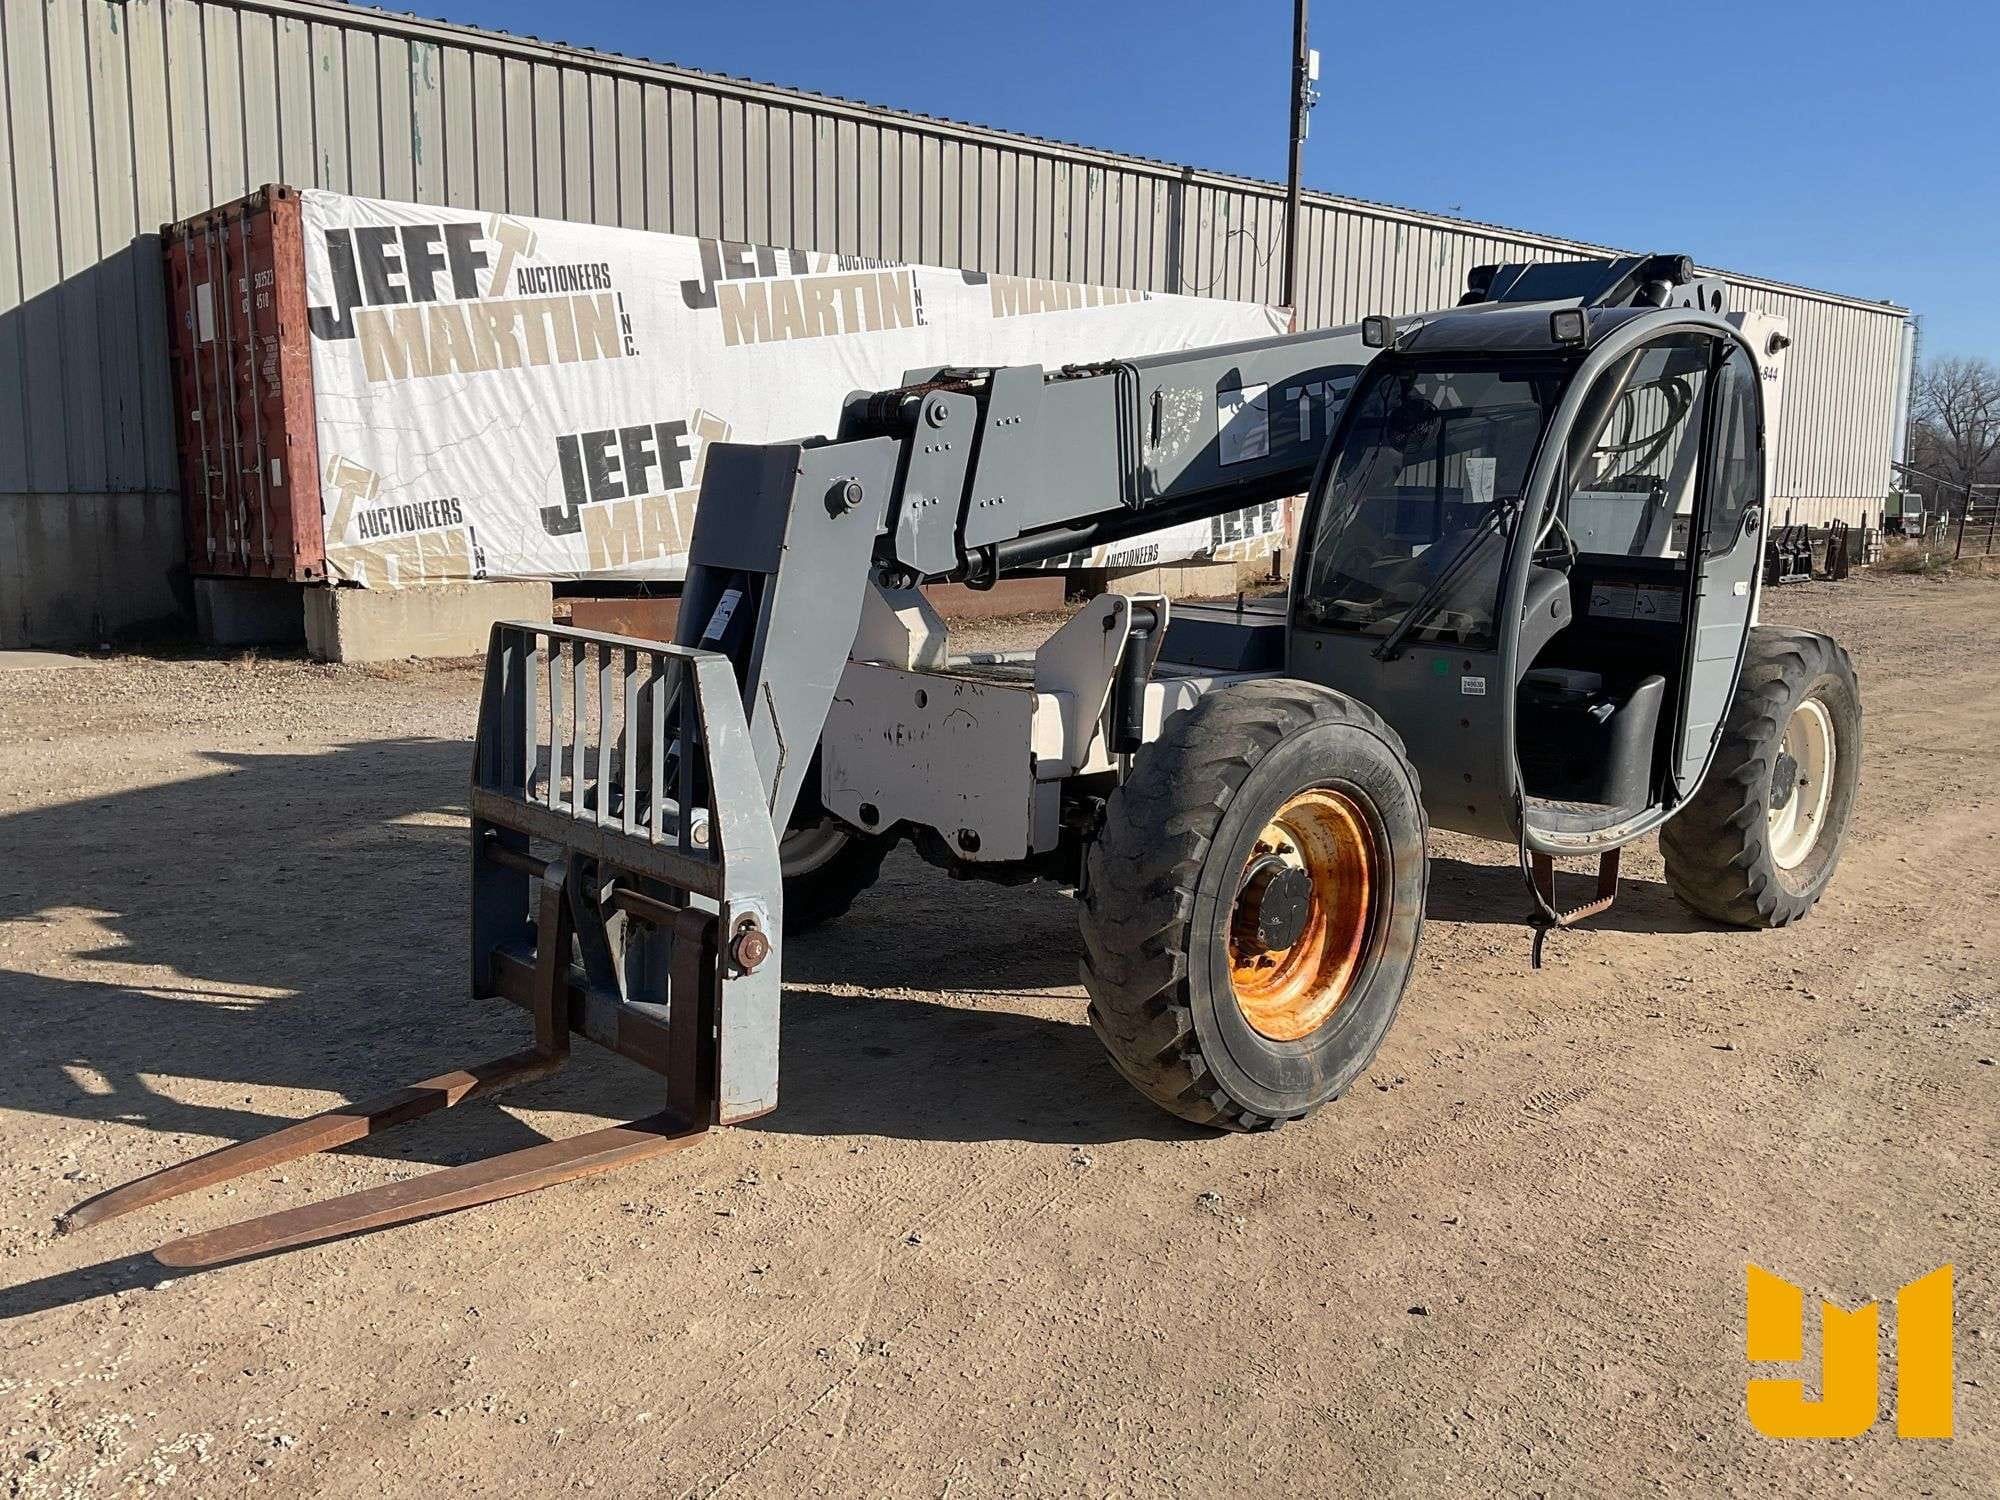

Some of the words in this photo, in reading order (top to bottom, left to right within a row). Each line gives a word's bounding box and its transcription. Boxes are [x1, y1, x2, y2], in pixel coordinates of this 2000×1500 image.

[308, 222, 489, 341] JEFF
[517, 262, 613, 295] AUCTIONEERS
[716, 269, 915, 347] MARTIN
[355, 294, 622, 383] MARTIN
[617, 292, 640, 366] INC.
[539, 419, 692, 537] JEFF
[358, 497, 463, 540] AUCTIONEERS
